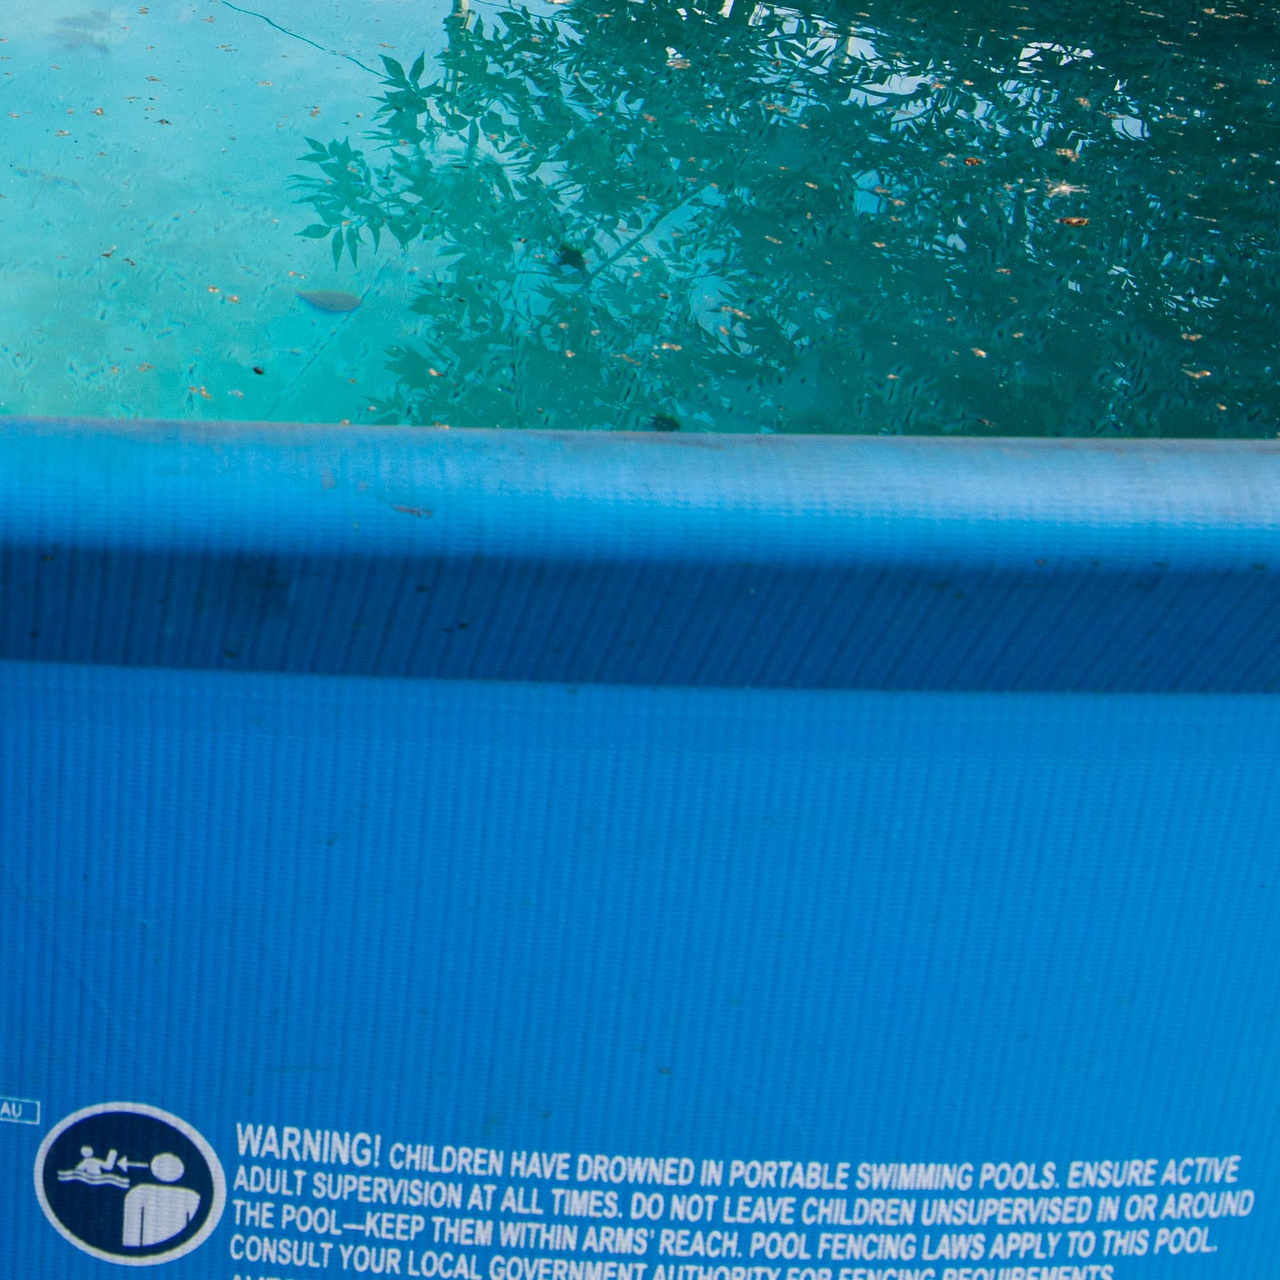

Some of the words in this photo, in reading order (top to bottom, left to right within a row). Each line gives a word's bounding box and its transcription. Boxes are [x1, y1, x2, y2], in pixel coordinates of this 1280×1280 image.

[1, 1101, 22, 1119] AU
[237, 1122, 381, 1168] WARNING!
[389, 1143, 503, 1177] CHILDREN
[510, 1151, 571, 1181] HAVE
[577, 1154, 694, 1186] DROWNED
[700, 1159, 723, 1187] IN
[729, 1160, 850, 1190] PORTABLE
[855, 1162, 974, 1191] SWIMMING
[979, 1161, 1060, 1190] POOLS.
[1067, 1159, 1158, 1189] ENSURE
[1161, 1155, 1241, 1186] ACTIVE
[233, 1165, 306, 1197] ADULT
[313, 1172, 462, 1209] SUPERVISION
[467, 1184, 497, 1211] AT
[501, 1186, 543, 1215] ALL
[551, 1187, 623, 1219] TIMES.
[630, 1191, 664, 1220] DO
[670, 1194, 718, 1222] NOT
[723, 1196, 796, 1225] LEAVE
[802, 1197, 917, 1225] CHILDREN
[921, 1195, 1093, 1226] UNSUPERVISED
[1096, 1195, 1121, 1223] IN
[1124, 1194, 1158, 1222] OR
[1160, 1189, 1255, 1220] AROUND
[230, 1234, 334, 1268] CONSULT
[339, 1243, 401, 1274] YOUR
[408, 1249, 482, 1280] LOCAL
[489, 1255, 648, 1280] GOVERNMENT
[233, 1199, 274, 1228] THE
[431, 1216, 493, 1246] THEM
[500, 1221, 578, 1251] WITHIN
[582, 1226, 655, 1255] ARMS'
[659, 1229, 743, 1258] REACH.
[750, 1232, 811, 1260] POOL
[817, 1233, 917, 1261] FENCING
[922, 1233, 986, 1261] LAWS
[988, 1231, 1061, 1260] APPLY
[1068, 1230, 1096, 1258] TO
[1102, 1228, 1149, 1257] THIS
[1154, 1226, 1218, 1255] POOL.
